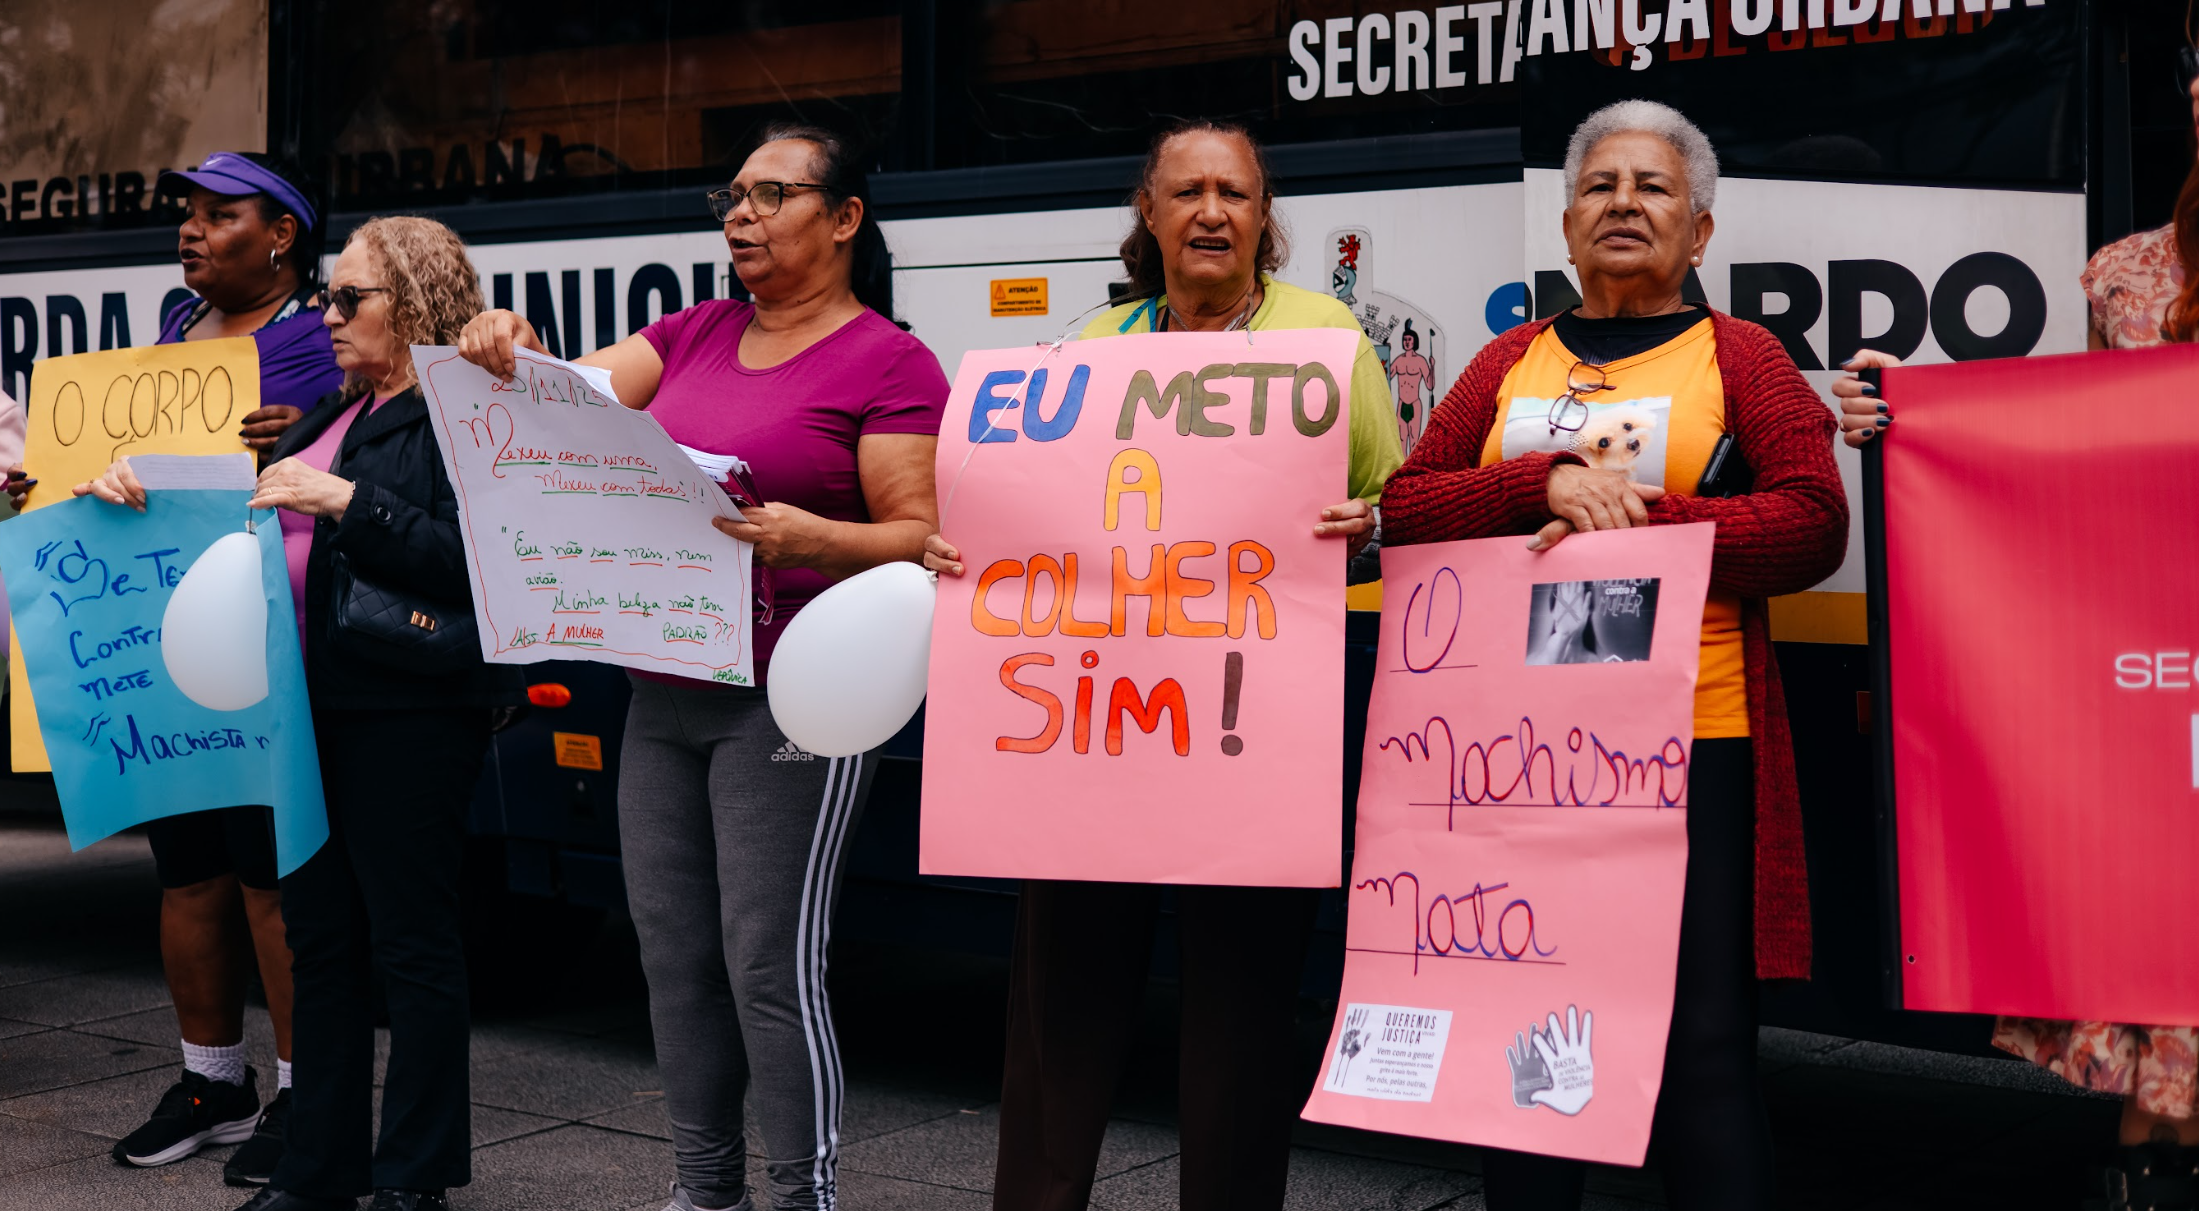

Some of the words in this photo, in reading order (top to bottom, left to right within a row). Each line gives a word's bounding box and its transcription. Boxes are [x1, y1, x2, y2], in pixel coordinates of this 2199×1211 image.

[1009, 286, 1038, 294] ATENÇÃO
[53, 381, 84, 446] O
[102, 366, 234, 438] CORPO
[968, 364, 1091, 443] EU
[1115, 361, 1341, 441] METO
[557, 451, 598, 464] com
[534, 469, 596, 491] Mexeu
[600, 481, 636, 493] com
[1103, 448, 1162, 532] A
[550, 541, 583, 555] não
[590, 547, 617, 558] sou
[675, 549, 712, 562] nem
[970, 539, 1277, 641] COLHER
[1605, 587, 1630, 595] contra
[552, 589, 609, 613] Minha
[668, 595, 695, 609] não
[699, 595, 724, 612] tem
[1600, 594, 1643, 617] MULHER
[1403, 566, 1463, 674] O
[545, 622, 556, 642] A
[562, 623, 605, 642] MULHER
[662, 622, 708, 642] PADRÃO
[2115, 651, 2199, 689] SE
[771, 751, 815, 762] adidas
[1356, 871, 1558, 977] Mata
[1385, 1012, 1437, 1030] QUEREMOS
[1381, 1027, 1421, 1047] JUSTIÇA
[1377, 1047, 1391, 1056] Vem
[1392, 1050, 1406, 1058] com
[1412, 1052, 1435, 1061] gente!
[1553, 1058, 1577, 1070] BASTA
[1366, 1075, 1376, 1083] Por
[1389, 1077, 1406, 1086] pelas
[1557, 1075, 1578, 1085] CONTRA
